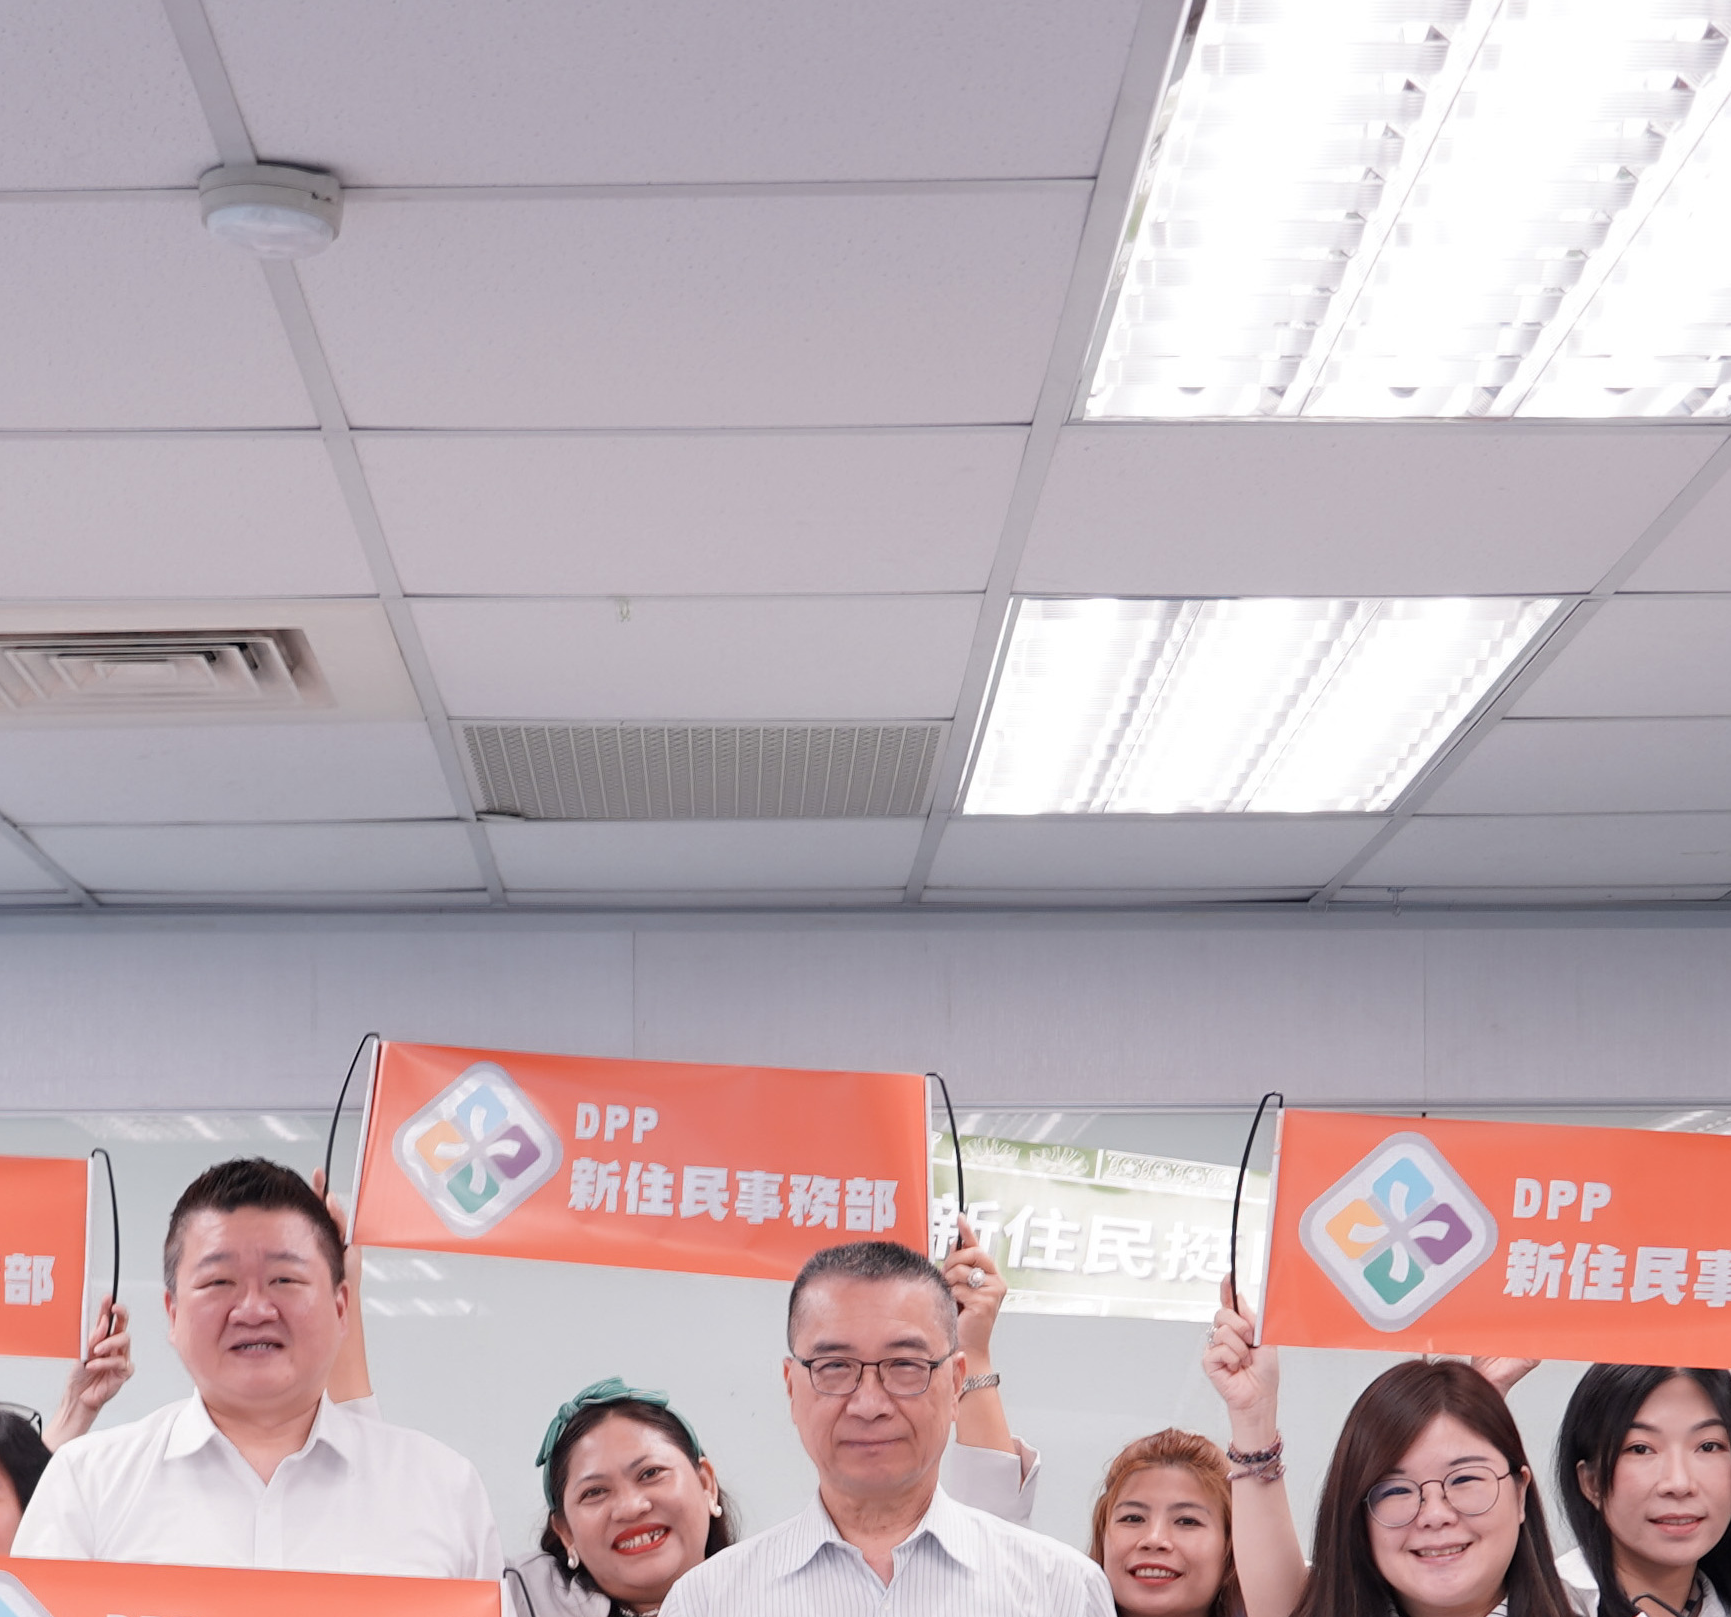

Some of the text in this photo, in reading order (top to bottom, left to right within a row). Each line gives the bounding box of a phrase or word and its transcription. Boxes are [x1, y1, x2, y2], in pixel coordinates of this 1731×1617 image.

[575, 1102, 659, 1144] DPP
[568, 1157, 898, 1232] 新住民事務部
[1512, 1177, 1611, 1222] DPP
[933, 1192, 1267, 1285] 新住民挺
